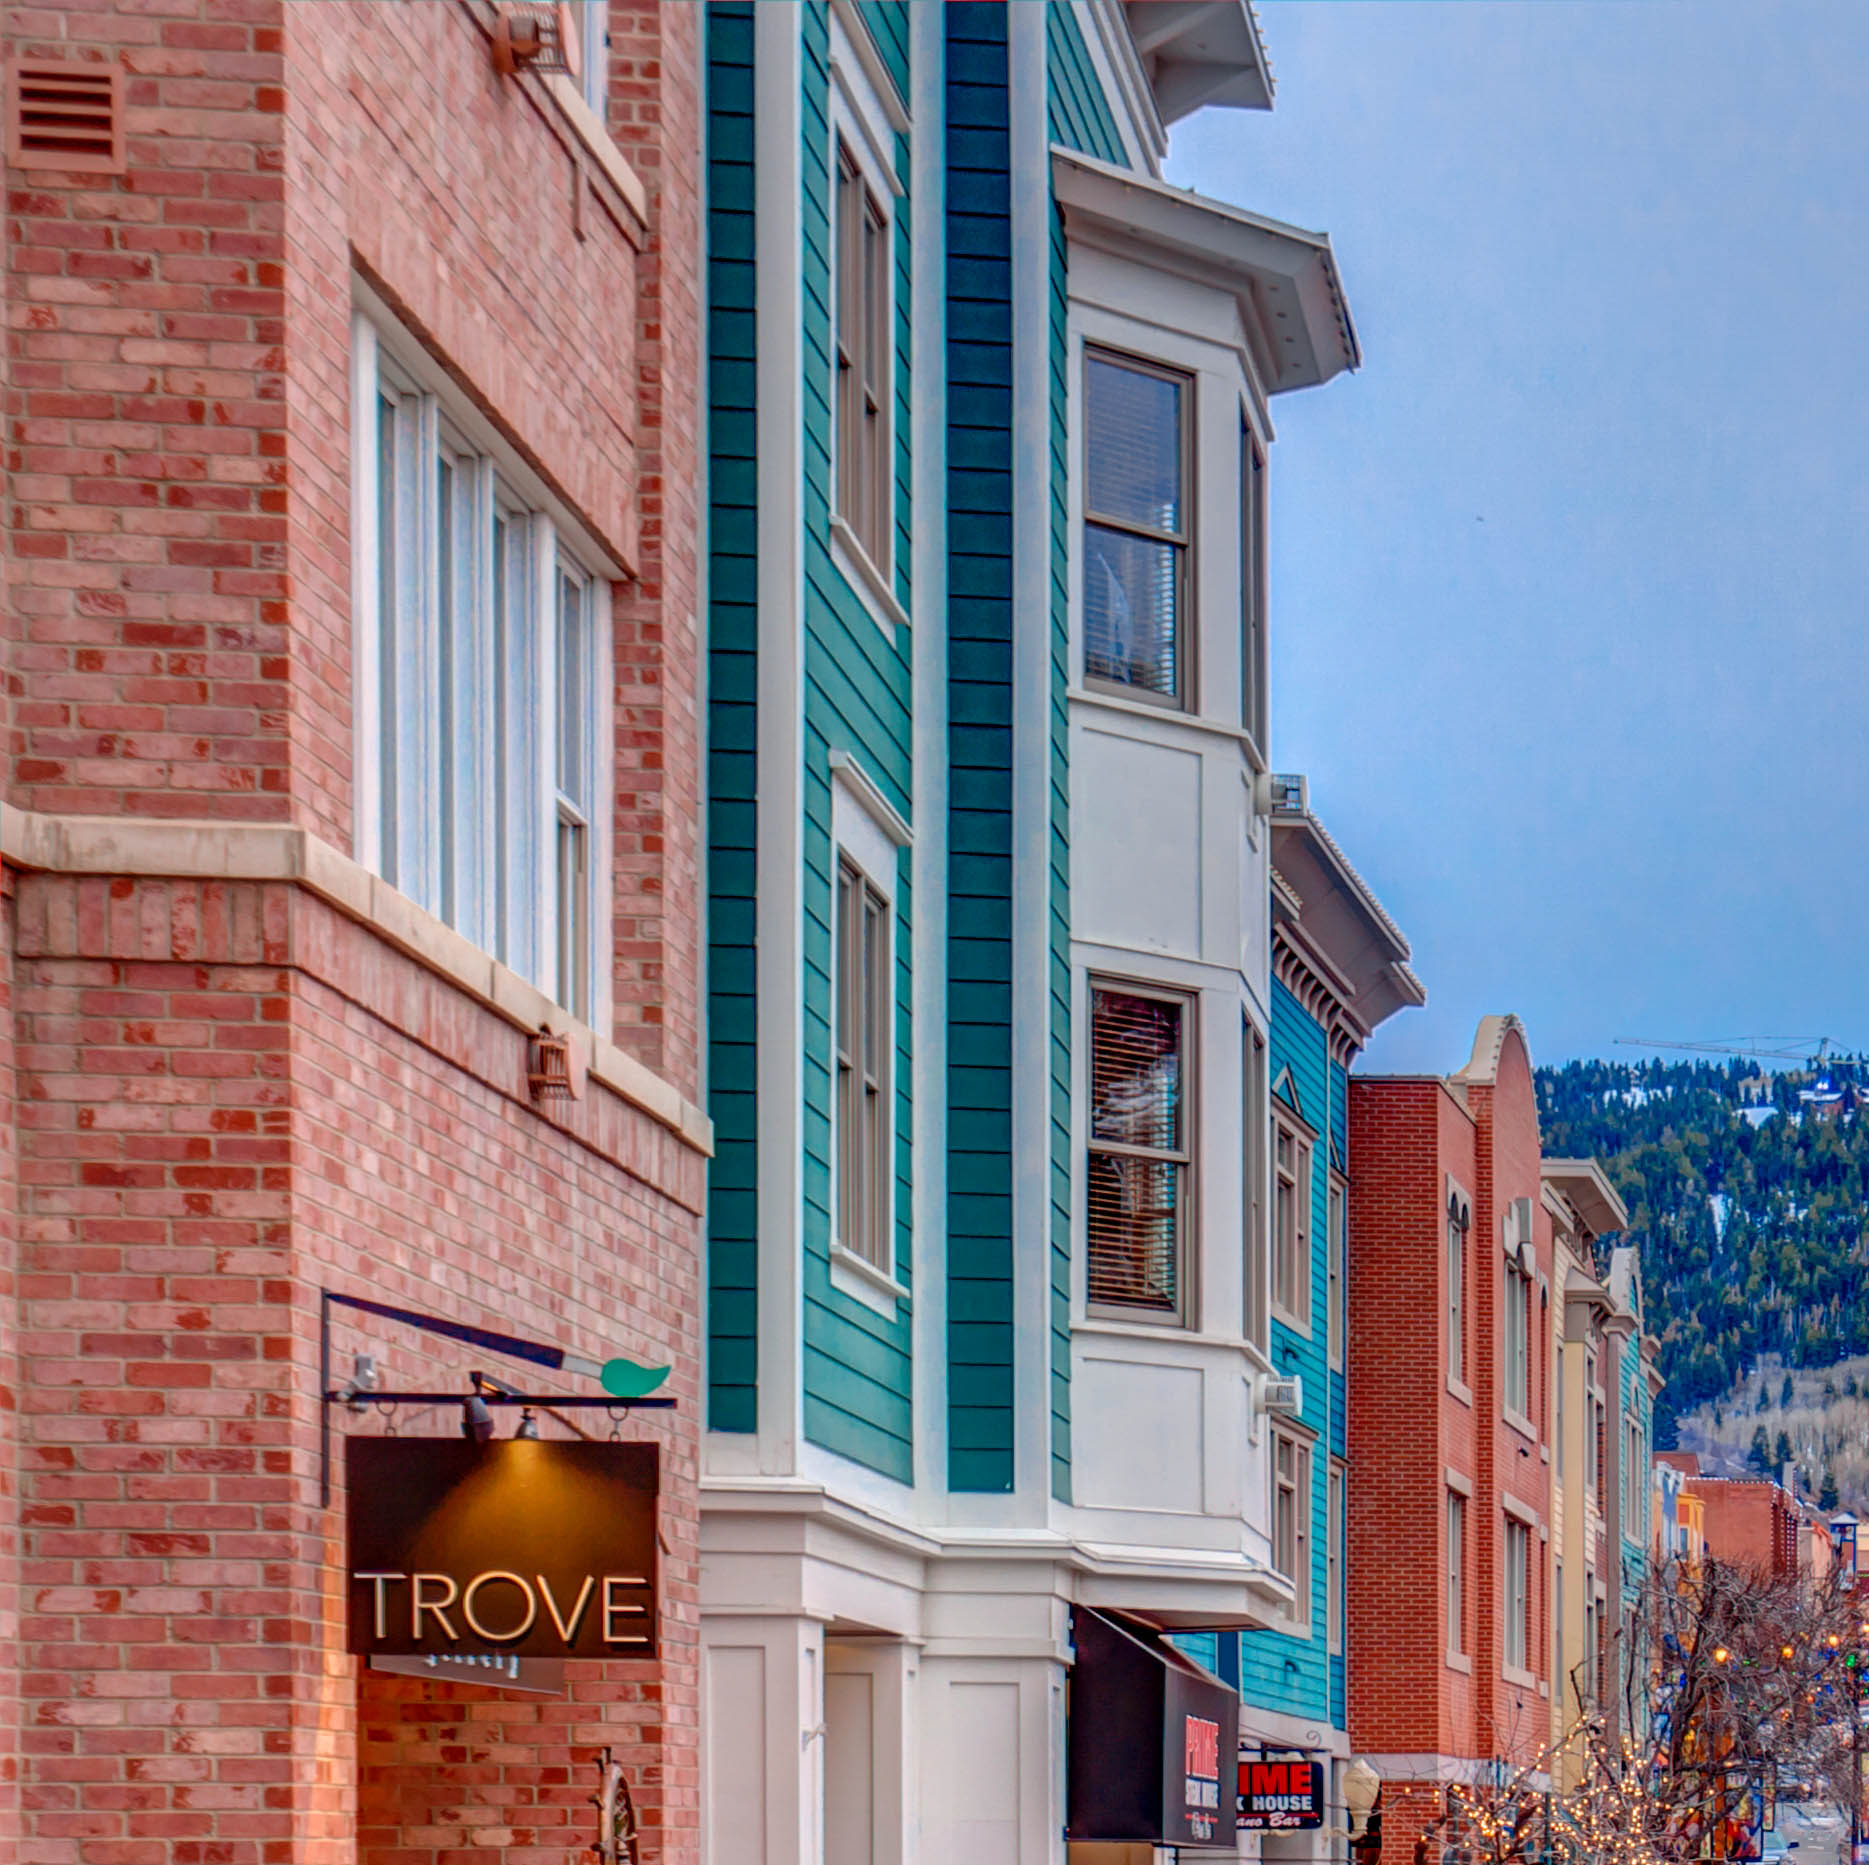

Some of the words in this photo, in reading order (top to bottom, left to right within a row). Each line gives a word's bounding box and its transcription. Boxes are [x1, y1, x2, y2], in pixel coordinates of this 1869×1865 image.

[354, 1571, 649, 1643] TROVE
[1238, 1763, 1313, 1795] IME
[1252, 1795, 1312, 1811] HOUSE
[1269, 1811, 1301, 1827] Bar
